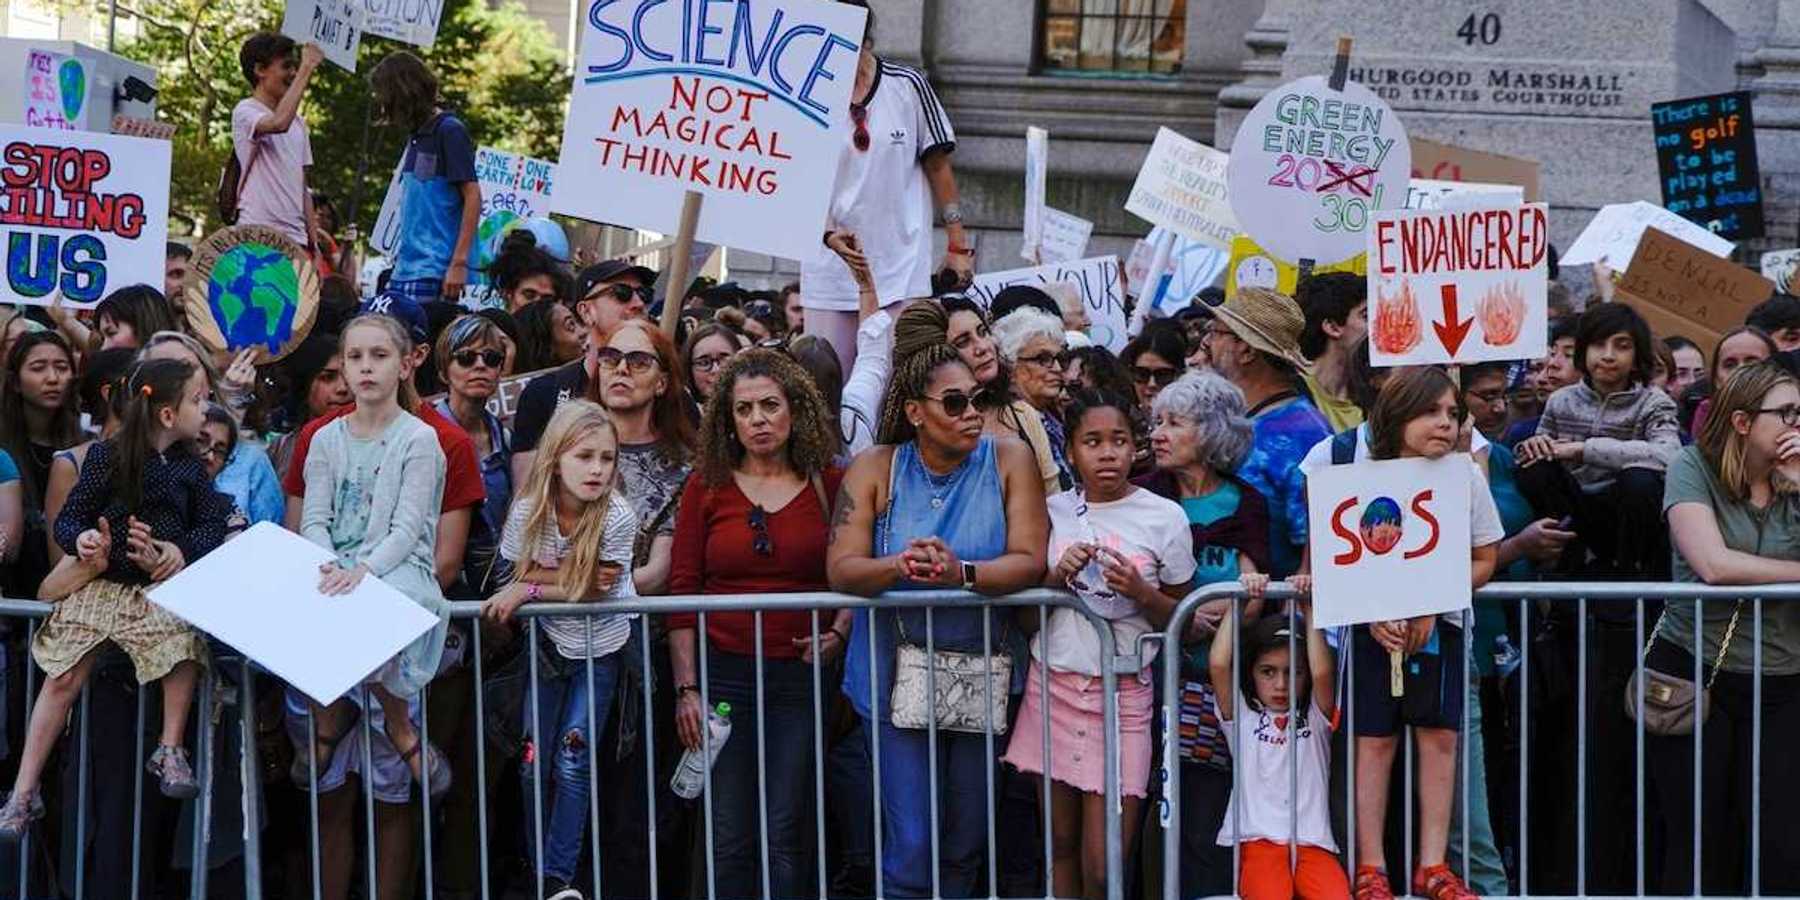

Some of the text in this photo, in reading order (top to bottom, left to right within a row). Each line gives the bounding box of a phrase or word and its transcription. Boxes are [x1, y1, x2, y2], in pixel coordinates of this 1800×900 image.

[1457, 13, 1501, 46] 40
[588, 0, 859, 114] SCIENCE
[1349, 67, 1624, 91] HURGOOD MARSHALL
[669, 76, 768, 121] NOT
[1276, 94, 1384, 135] GREEN
[1412, 88, 1480, 102] STATES
[1492, 90, 1624, 107] COURTHOUSE
[1653, 98, 1738, 125] There is
[611, 105, 791, 160] MAGICAL
[1264, 125, 1395, 169] ENERGY
[1657, 114, 1740, 150] no golf
[2, 141, 112, 193] STOP
[526, 161, 551, 180] ONE
[595, 138, 777, 195] THINKING
[1675, 149, 1737, 170] to be
[1377, 207, 1547, 275] ENDANGERED
[7, 231, 108, 303] US
[1643, 240, 1743, 303] DENIAL
[1627, 275, 1708, 319] IS NOT A
[1332, 489, 1440, 565] SOS
